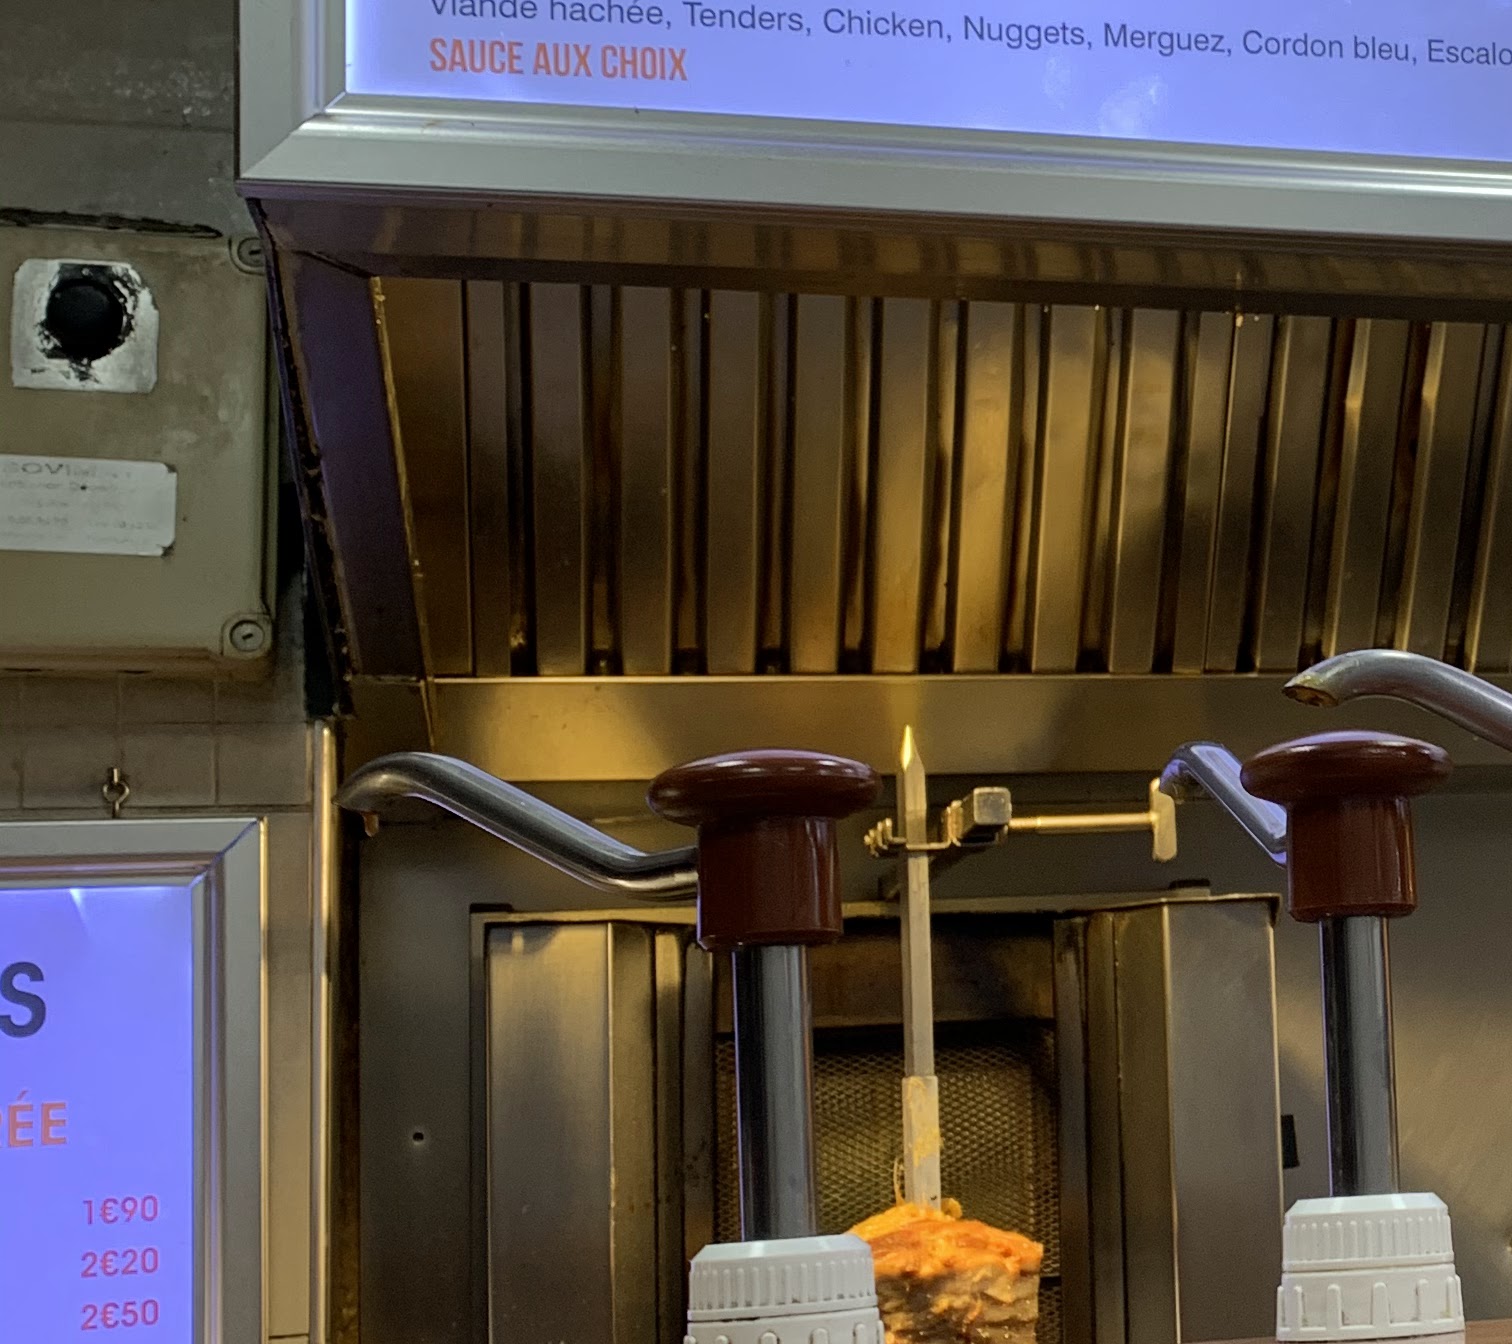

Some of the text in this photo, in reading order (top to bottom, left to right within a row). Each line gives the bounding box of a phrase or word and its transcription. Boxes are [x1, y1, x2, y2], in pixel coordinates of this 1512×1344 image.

[682, 0, 812, 37] Tenders,
[822, 7, 952, 43] Chicken,
[963, 14, 1093, 52] Nuggets,
[1104, 22, 1233, 58] Merguez,
[1243, 29, 1344, 59] Cordon
[1353, 36, 1418, 65] bleu,
[429, 38, 688, 81] SAUCE AUX CHOIX
[83, 1195, 159, 1225] 1€90
[81, 1247, 159, 1278] 2€20
[81, 1299, 159, 1331] 2€50
